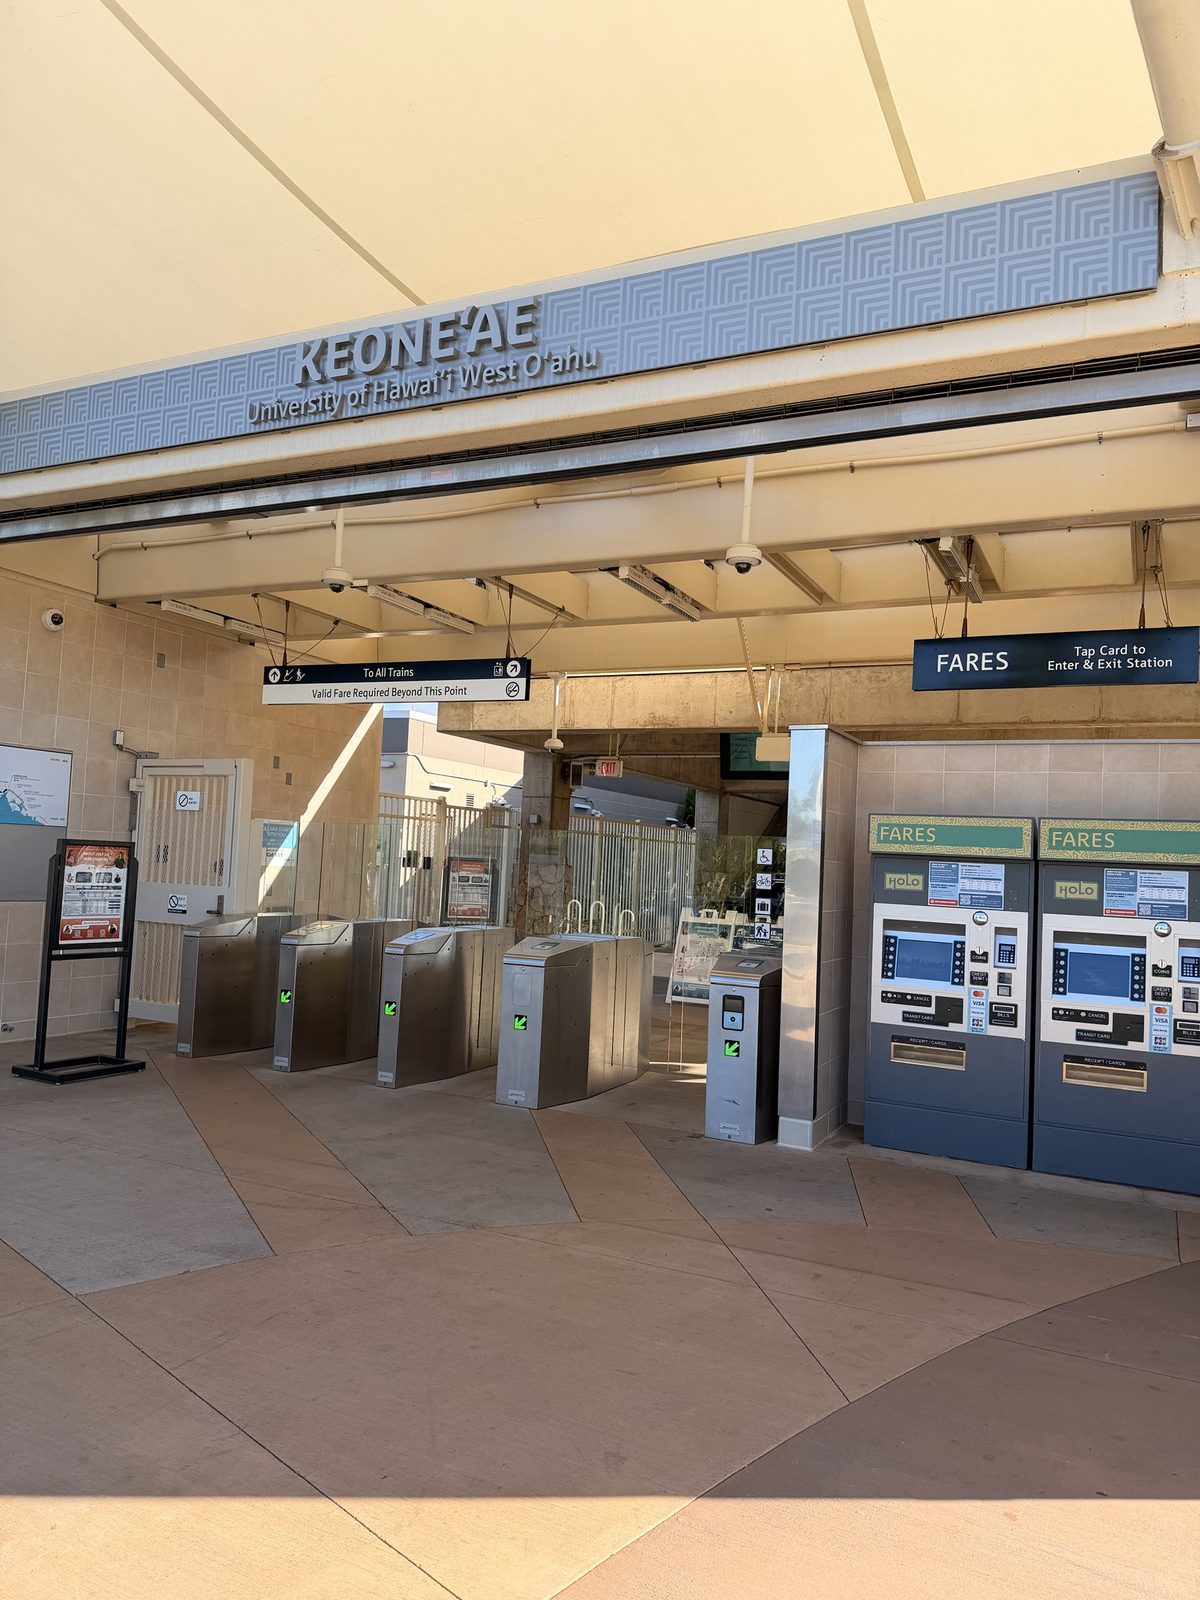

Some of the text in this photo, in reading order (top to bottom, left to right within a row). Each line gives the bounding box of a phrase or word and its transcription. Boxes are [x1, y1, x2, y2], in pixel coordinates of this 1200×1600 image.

[248, 391, 344, 423] University
[347, 381, 370, 407] of
[460, 360, 519, 389] West
[1074, 645, 1146, 658] Tap Card to
[937, 651, 1009, 672] FARES
[1048, 657, 1173, 671] Enter & Exit Station
[364, 666, 414, 678] To All Trains
[312, 685, 468, 699] Valid Fare Required Beyond This Point
[601, 761, 616, 776] EXIT
[880, 826, 936, 842] FARES
[1052, 832, 1115, 848] FARES
